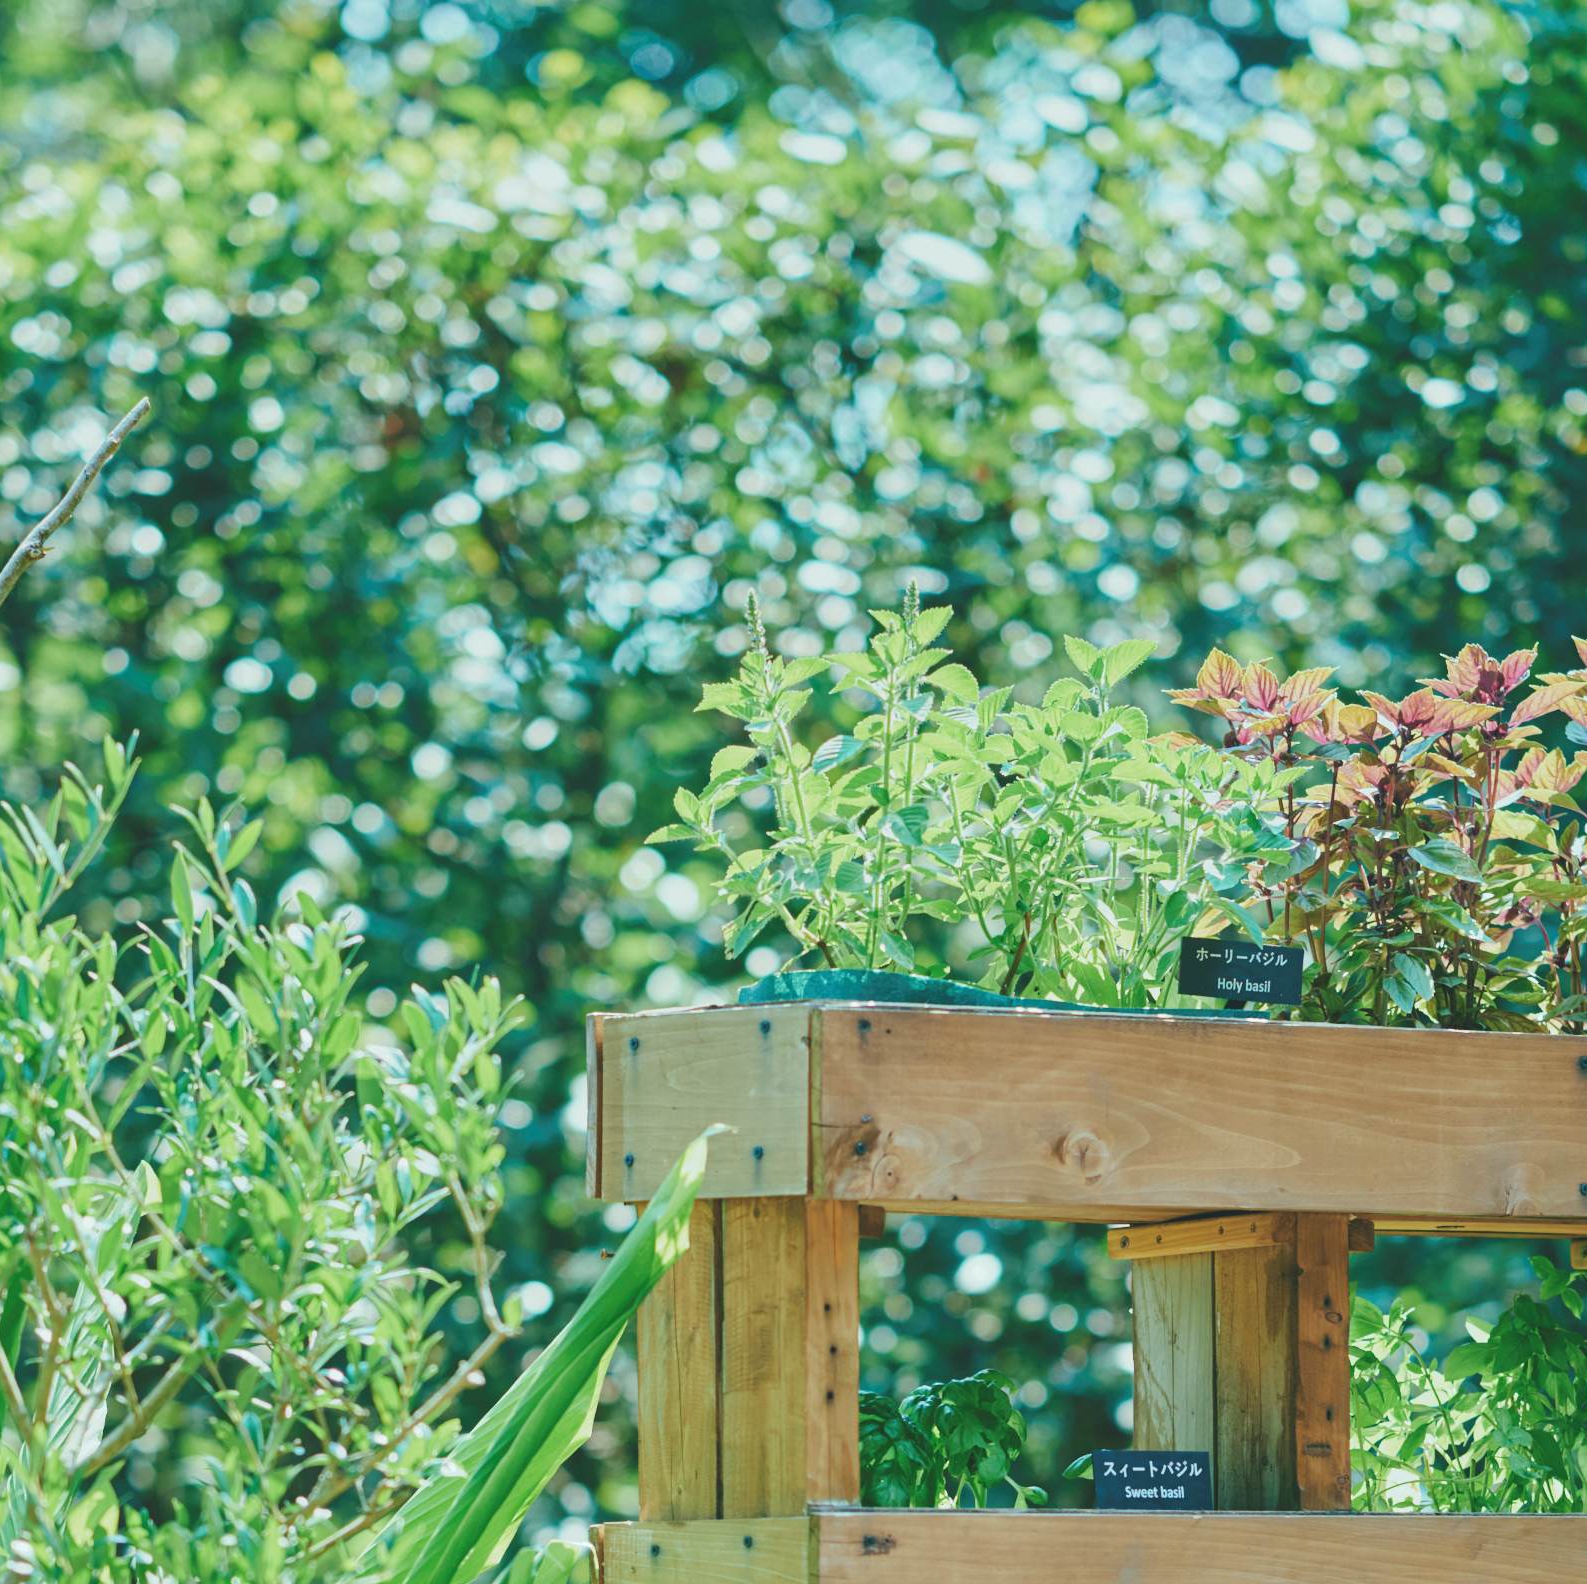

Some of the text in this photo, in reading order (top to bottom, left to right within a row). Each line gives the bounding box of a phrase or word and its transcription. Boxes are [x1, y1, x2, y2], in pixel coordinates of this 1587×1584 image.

[1196, 947, 1288, 967] ホーリーバジル
[1217, 978, 1271, 993] Holy basil
[1125, 1486, 1184, 1499] Sweet basil
